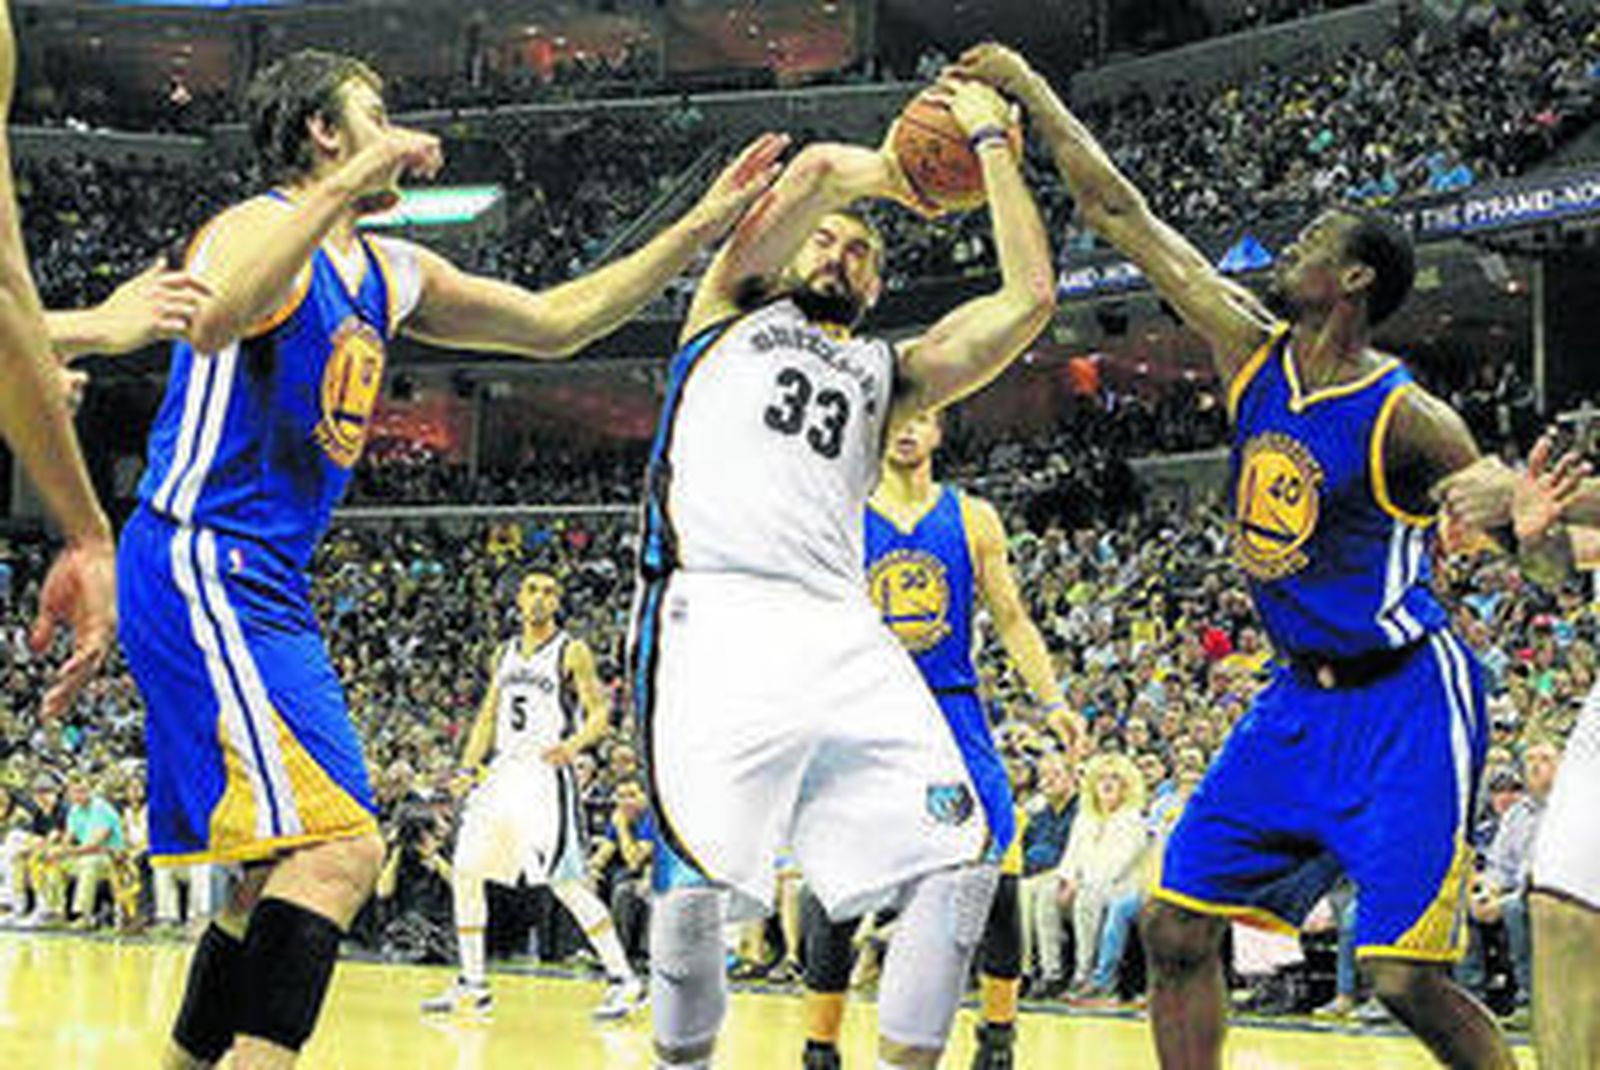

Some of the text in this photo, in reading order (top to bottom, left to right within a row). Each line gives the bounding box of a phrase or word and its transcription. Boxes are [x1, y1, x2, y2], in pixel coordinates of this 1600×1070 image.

[764, 367, 850, 460] 33
[1267, 473, 1301, 506] 40
[510, 695, 527, 731] 5
